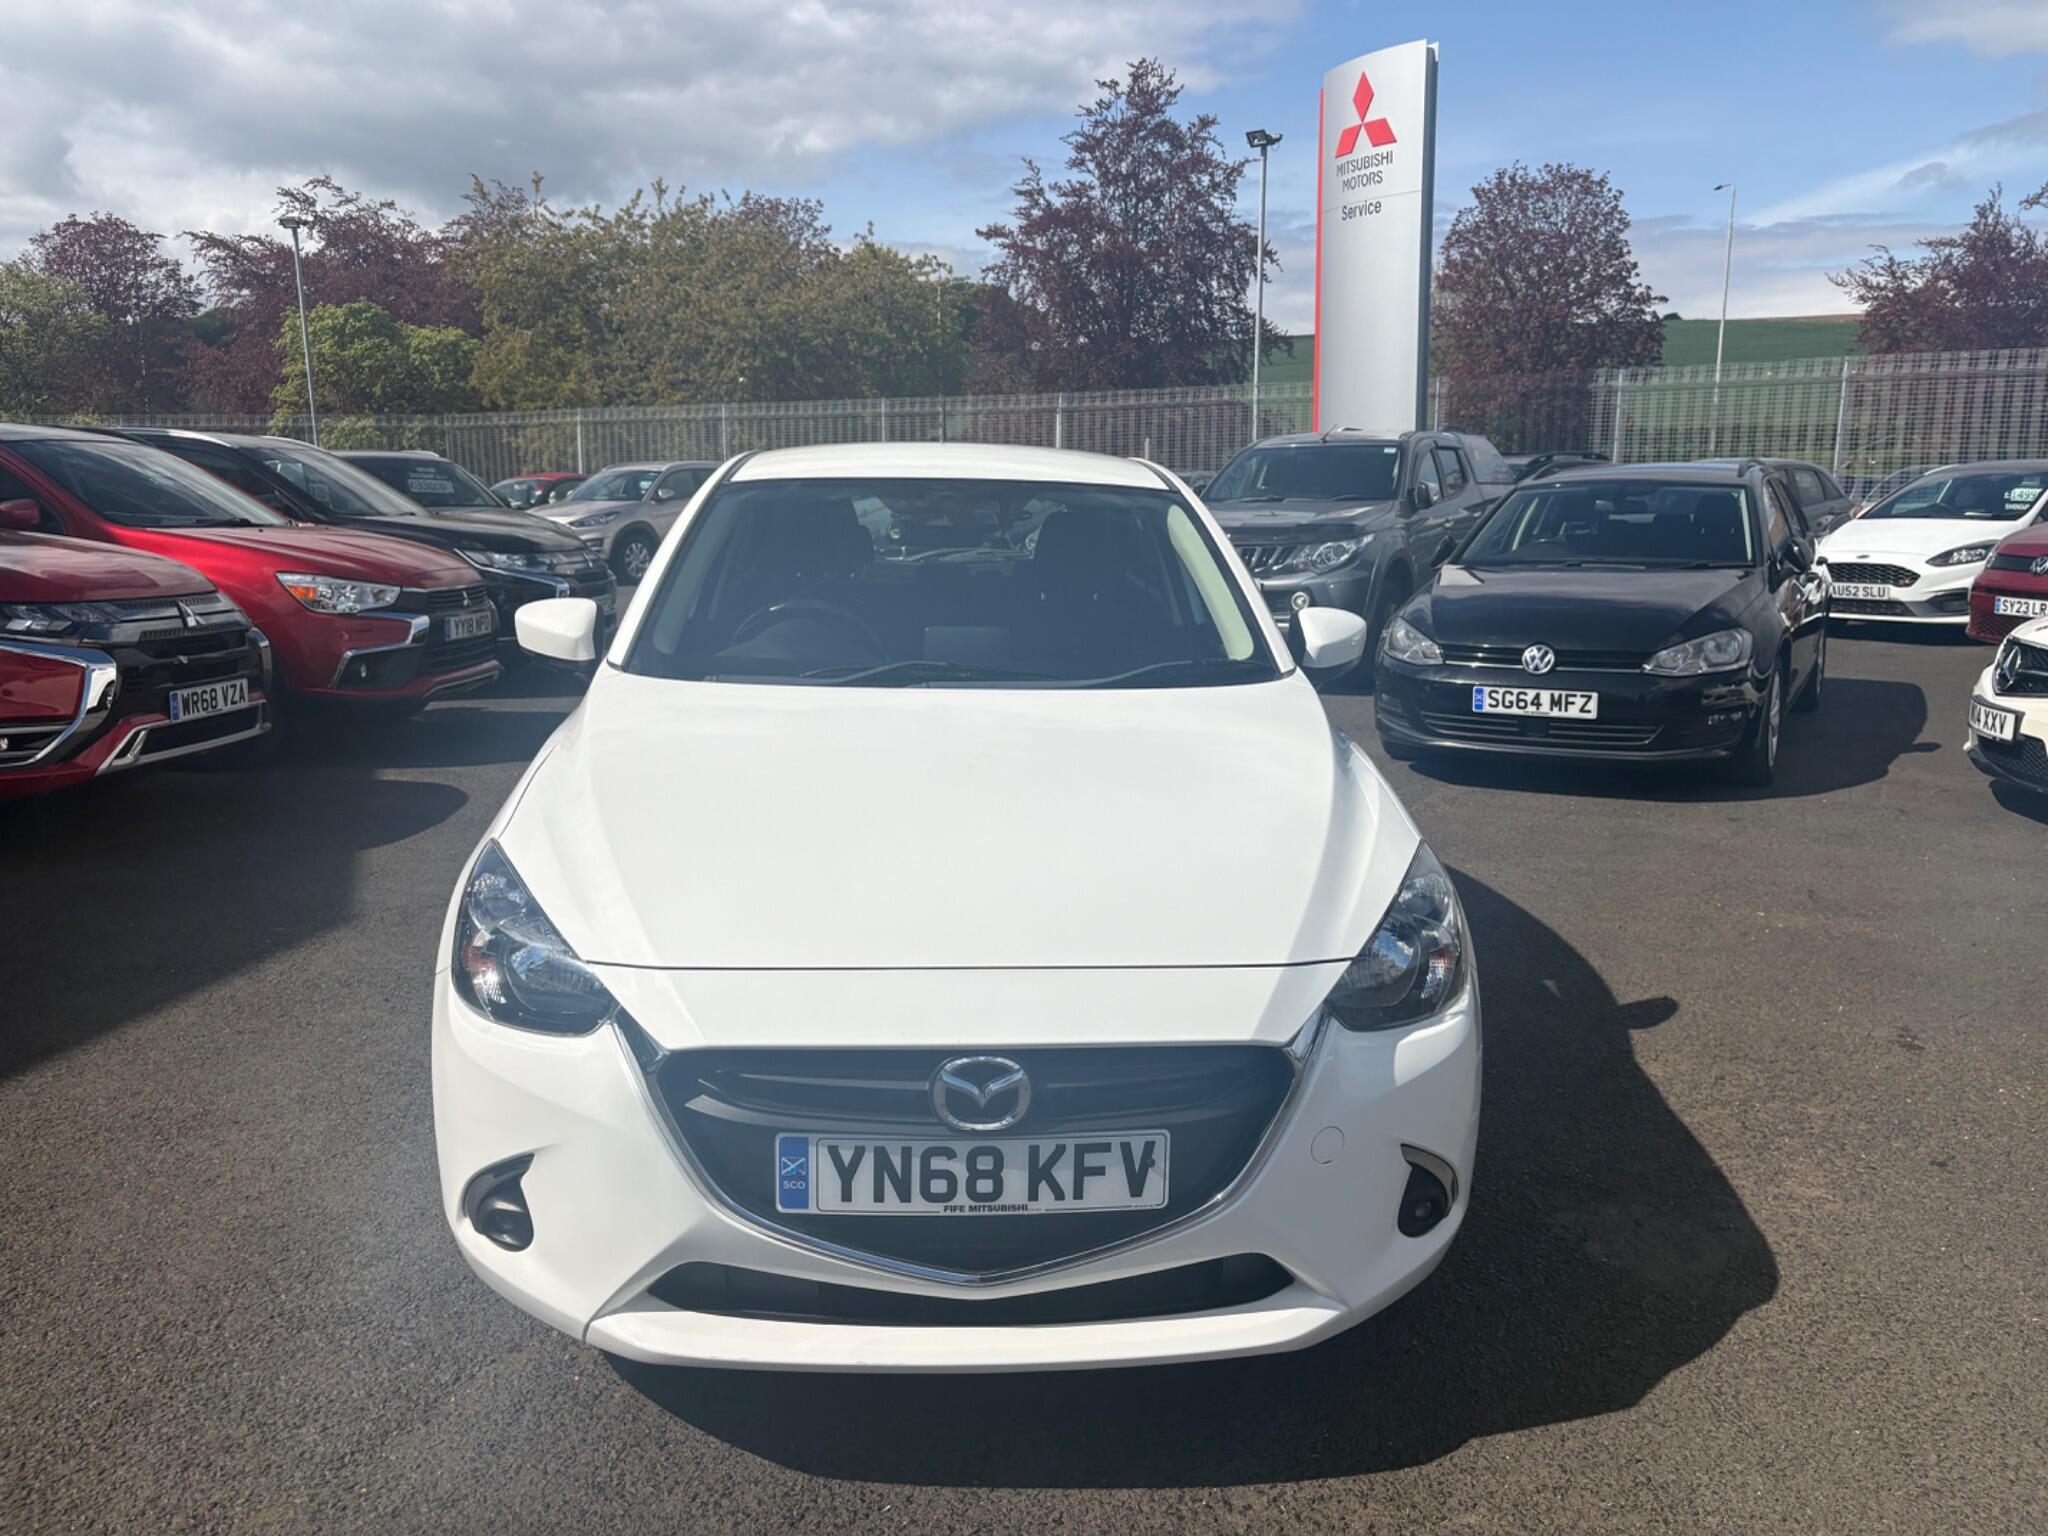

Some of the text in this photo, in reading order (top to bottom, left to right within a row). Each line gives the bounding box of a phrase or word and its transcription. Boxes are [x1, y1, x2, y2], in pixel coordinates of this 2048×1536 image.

[1336, 150, 1394, 177] MITSUBISHI
[1342, 170, 1384, 192] MOTORS
[1342, 200, 1382, 221] Service
[1862, 586, 1886, 598] SLU
[2002, 599, 2048, 617] SY23 LR
[181, 681, 246, 717] WR68 VZA
[1487, 690, 1593, 714] SG64 MFZ
[1983, 708, 2007, 735] XXV
[827, 1140, 1156, 1204] YN68 KFV
[783, 1180, 806, 1190] SCO
[943, 1205, 966, 1213] FIFE
[968, 1204, 1028, 1213] MITSUBISHI
